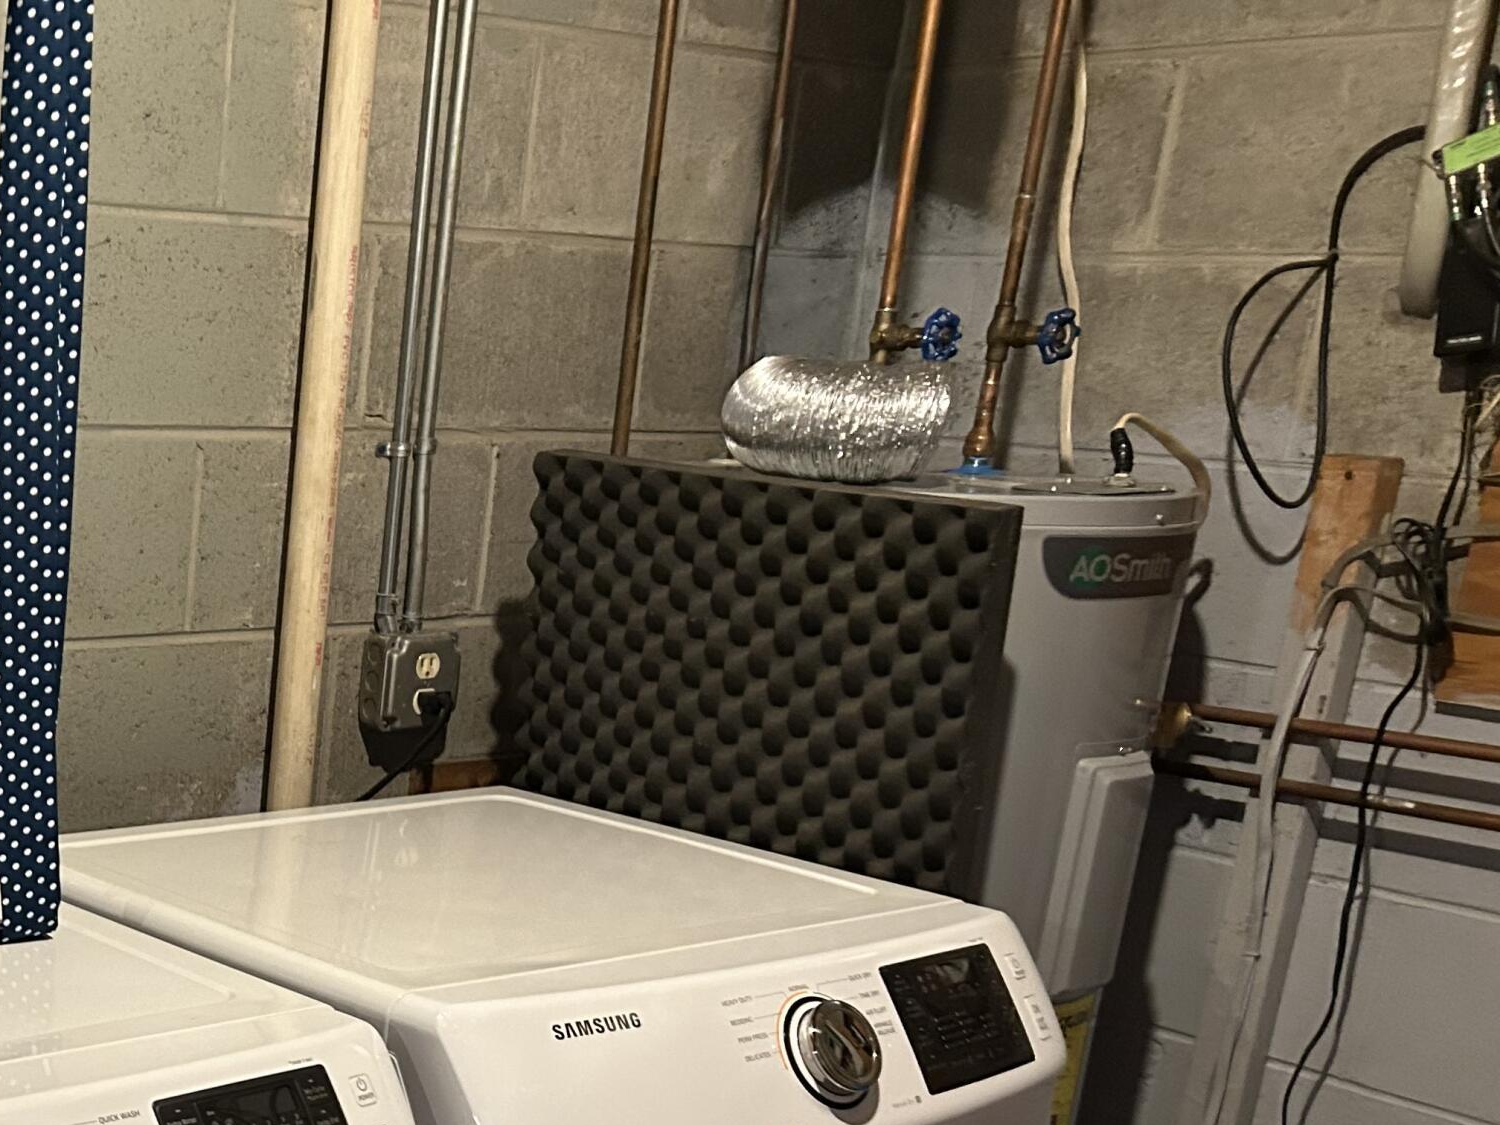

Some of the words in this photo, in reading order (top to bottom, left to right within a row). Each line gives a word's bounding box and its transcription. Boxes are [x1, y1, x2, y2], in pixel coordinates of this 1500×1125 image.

[552, 1012, 642, 1040] SAMSUNG
[98, 1113, 120, 1125] QUICK
[120, 1109, 140, 1120] WASH
